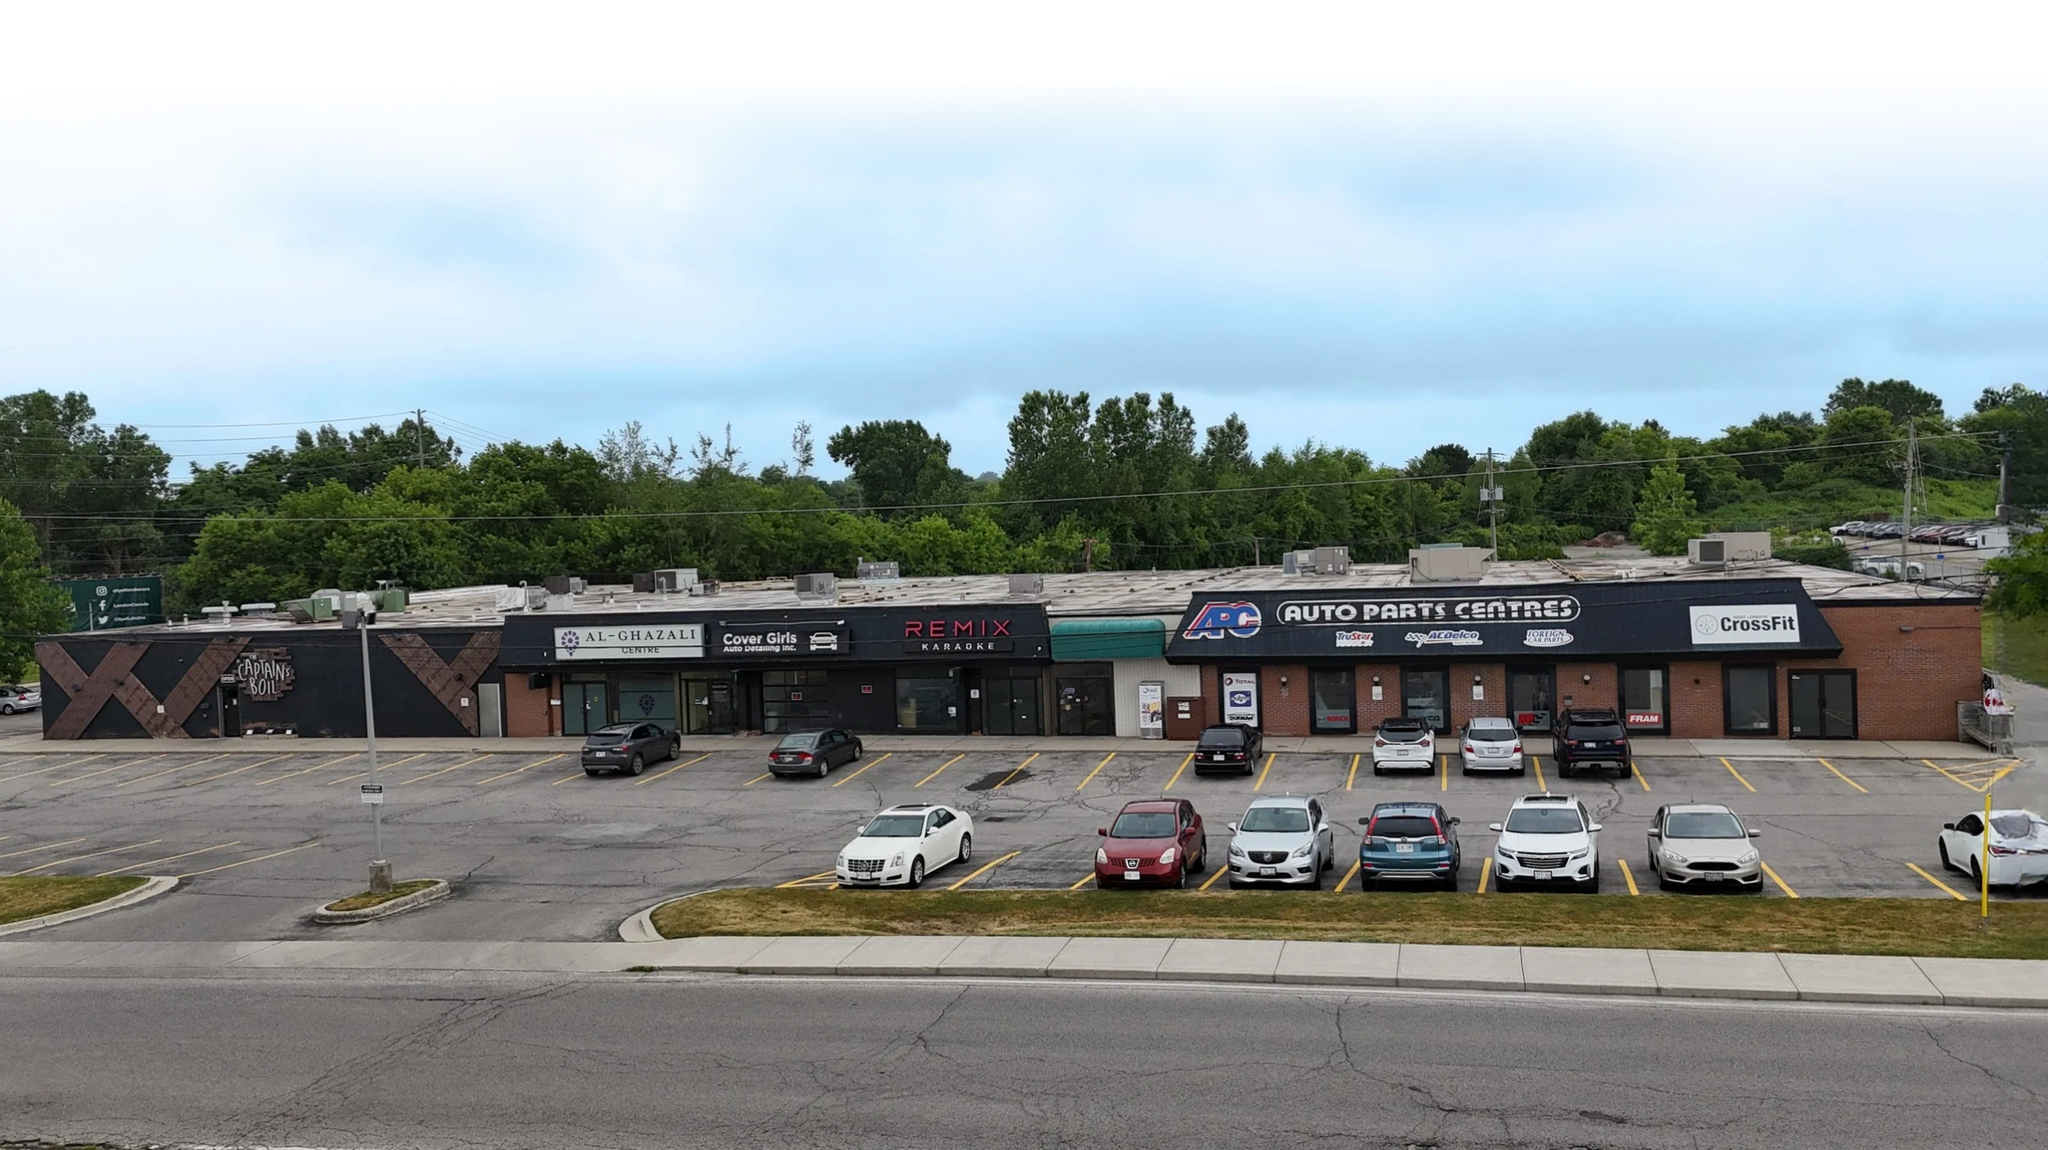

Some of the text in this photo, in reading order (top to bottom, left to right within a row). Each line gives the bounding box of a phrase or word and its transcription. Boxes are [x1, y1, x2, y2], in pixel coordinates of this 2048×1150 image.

[1284, 600, 1572, 622] AUTO PARTS CENTRES
[1183, 601, 1262, 639] APC
[1720, 616, 1796, 632] CrossFit
[905, 619, 1010, 637] REMIX
[585, 629, 696, 642] AL-GHAZALI
[722, 631, 798, 645] Cover Girls
[1428, 631, 1478, 639] ACDelco
[621, 646, 660, 654] CENTRE
[744, 644, 780, 653] Detailing
[921, 642, 995, 651] KARAOKE
[249, 677, 278, 695] BOIL
[1629, 715, 1659, 723] FRAM
